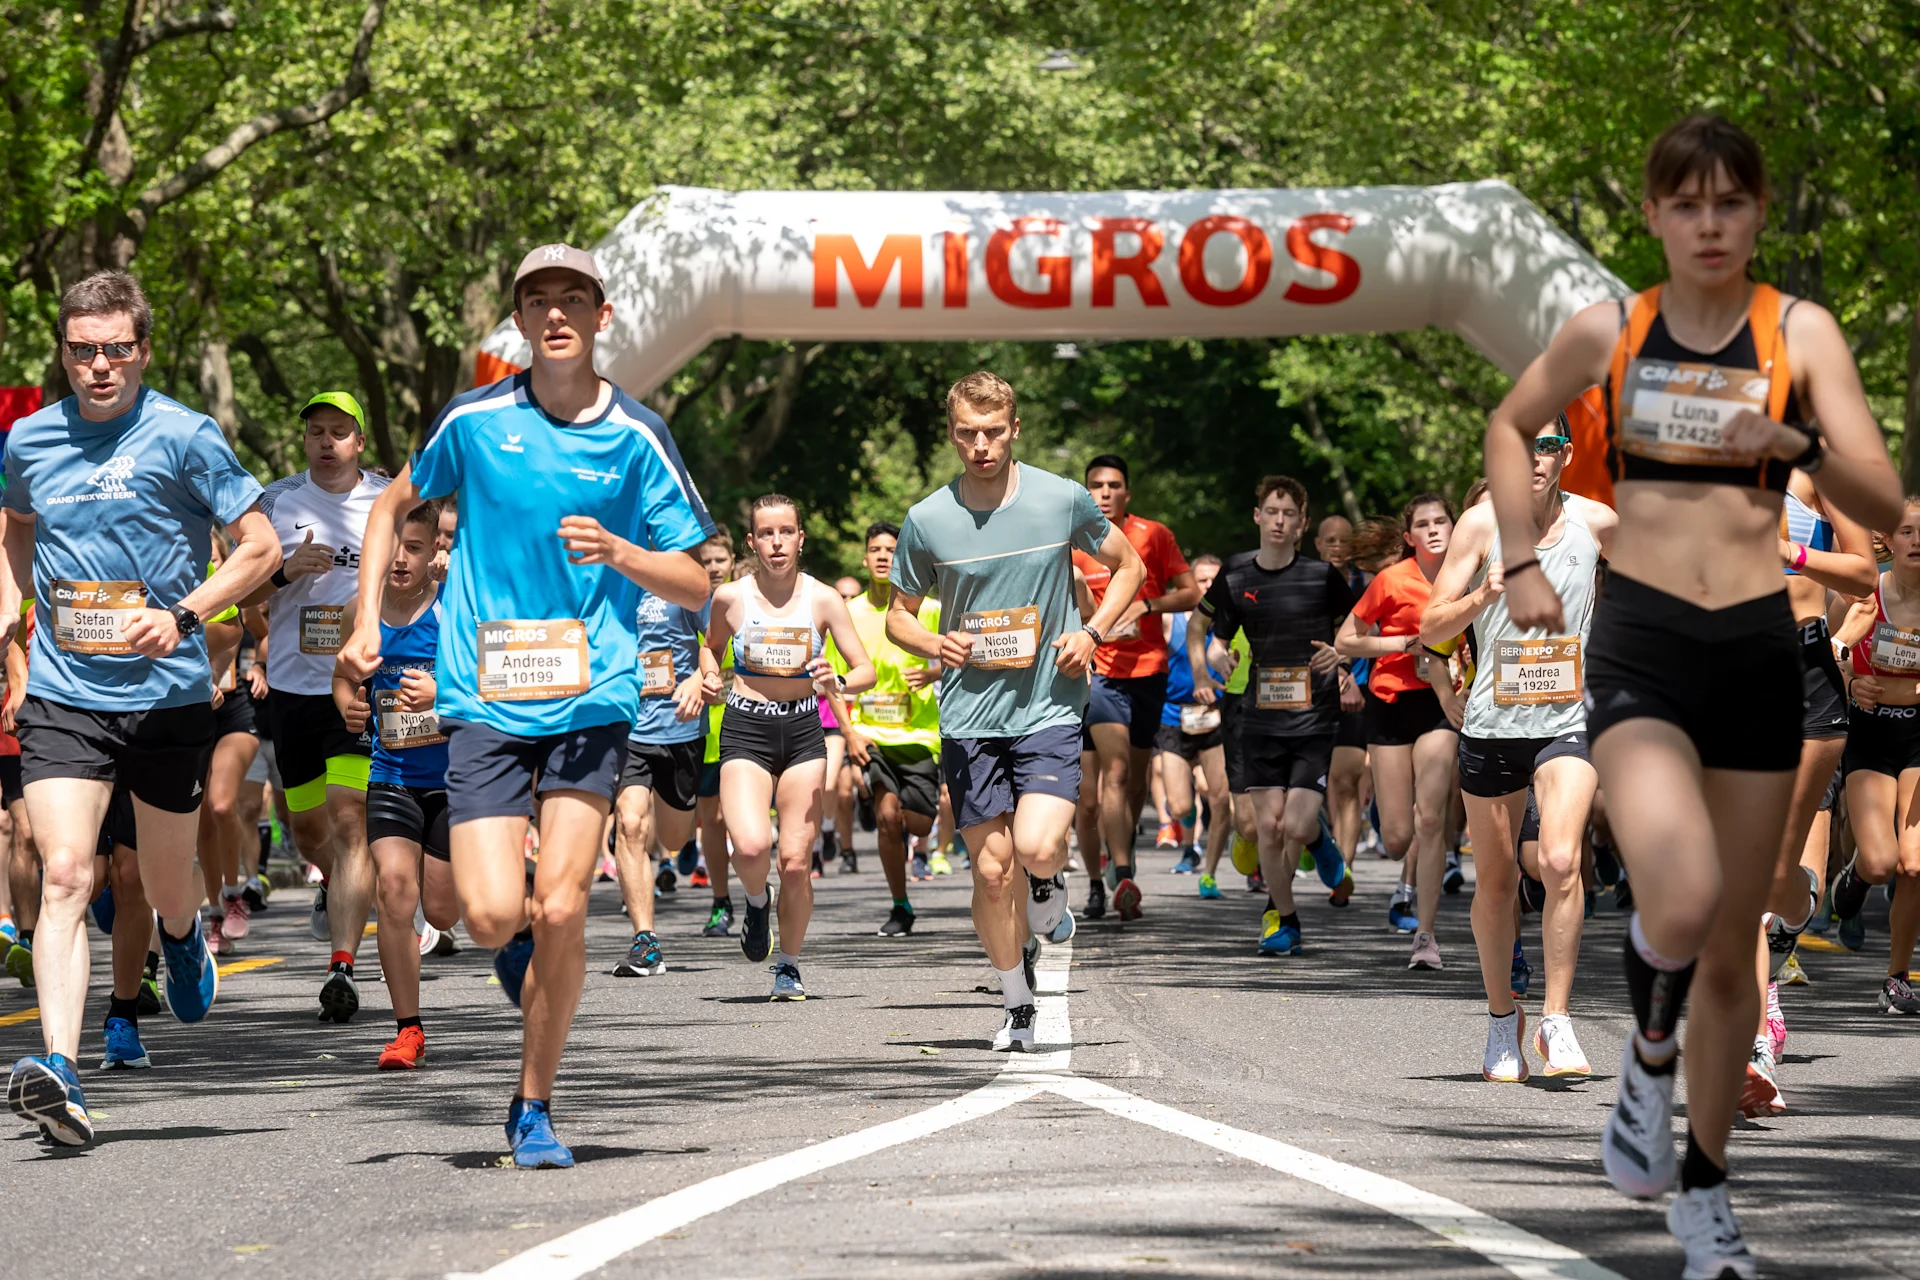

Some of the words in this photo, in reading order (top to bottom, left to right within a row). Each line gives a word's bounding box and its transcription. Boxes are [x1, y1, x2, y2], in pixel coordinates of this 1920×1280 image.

[813, 212, 1363, 309] MIGROS
[1639, 366, 1709, 386] CRAFT
[1672, 400, 1719, 424] Luna
[1666, 424, 1722, 445] 12425
[46, 495, 75, 505] GRAND
[95, 492, 113, 501] VON
[113, 491, 136, 499] BERN
[56, 588, 98, 601] CRAFT
[74, 612, 114, 626] Stefan
[305, 610, 344, 620] MIGROS
[964, 615, 1011, 630] MIGROS
[76, 628, 114, 640] 20005
[484, 628, 548, 645] MIGROS
[984, 634, 1018, 647] Nicola
[1880, 627, 1920, 642] BERNEXPO
[987, 646, 1018, 658] 16399
[1500, 645, 1554, 657] BERNEXPO
[1895, 646, 1917, 659] Lena
[502, 655, 562, 669] Andreas
[765, 658, 791, 666] 11434
[512, 671, 554, 684] 10199
[1518, 667, 1560, 679] Andrea
[1522, 680, 1557, 691] 19292
[753, 700, 790, 715] PRO
[794, 694, 819, 714] NIK
[400, 714, 425, 725] Nino
[1878, 707, 1917, 719] PRO
[400, 724, 431, 737] 12713
